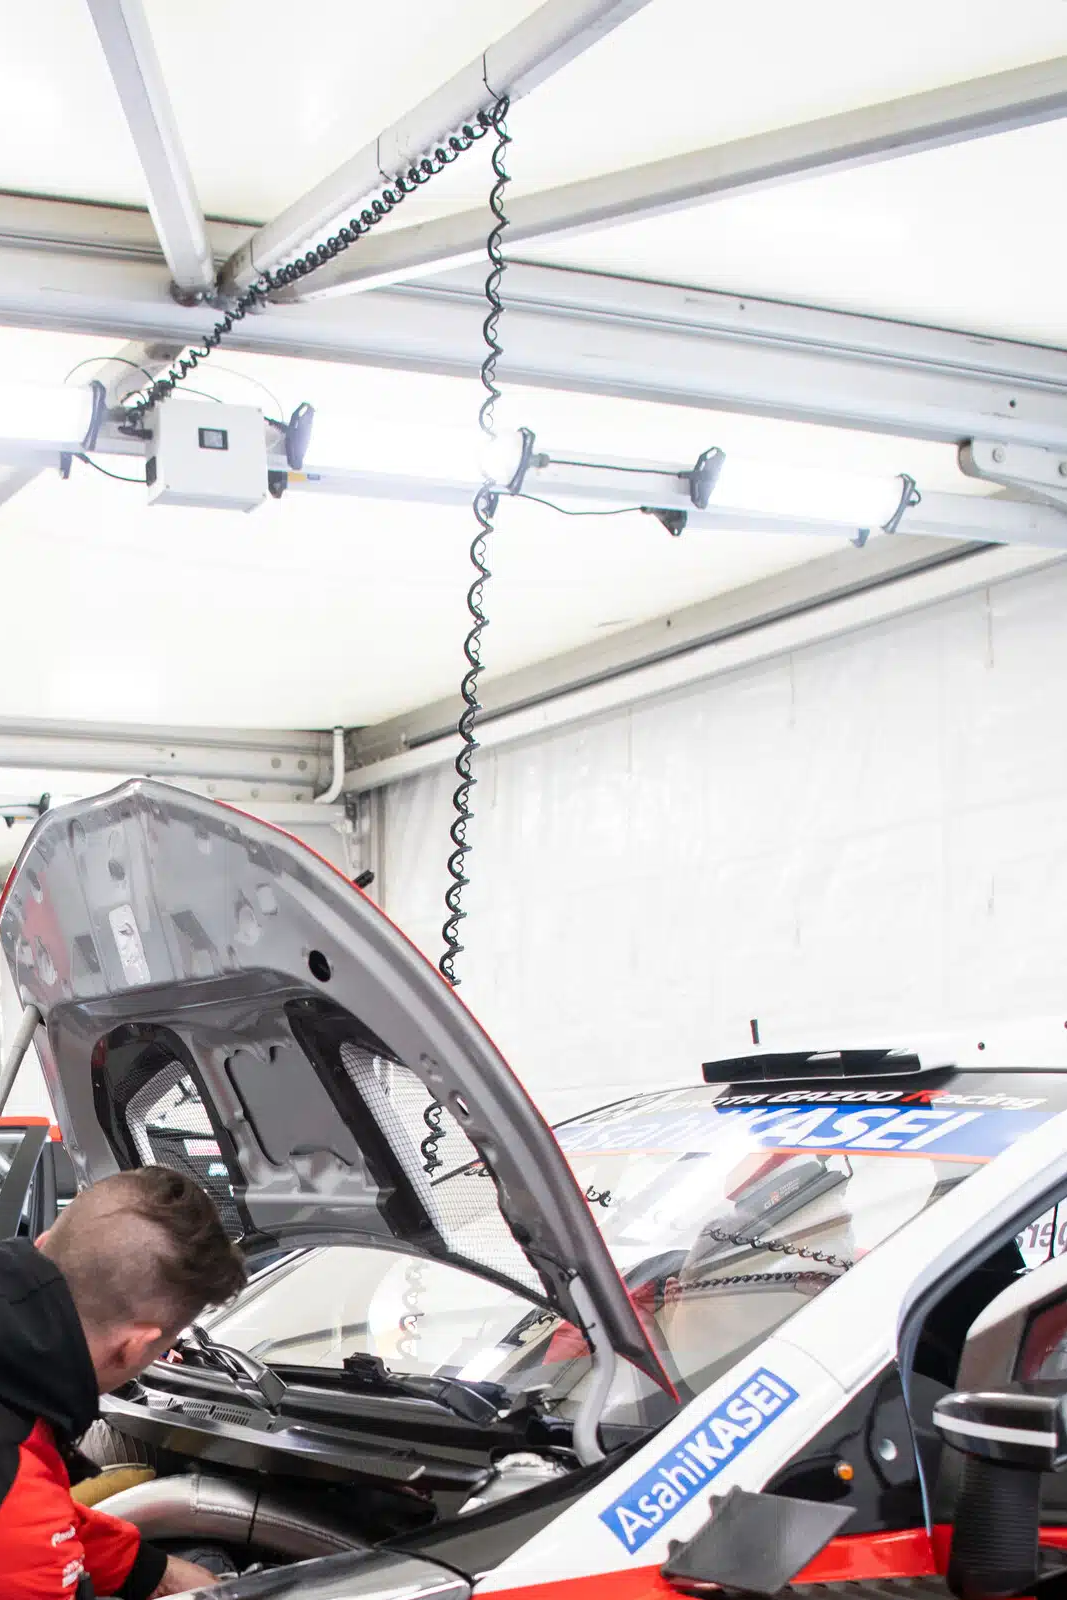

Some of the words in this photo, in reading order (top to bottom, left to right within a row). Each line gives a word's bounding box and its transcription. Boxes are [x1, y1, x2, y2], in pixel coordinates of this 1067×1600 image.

[767, 1090, 903, 1104] GAZOO
[901, 1089, 1048, 1111] Racing
[615, 1374, 791, 1545] AsahiKASEI
